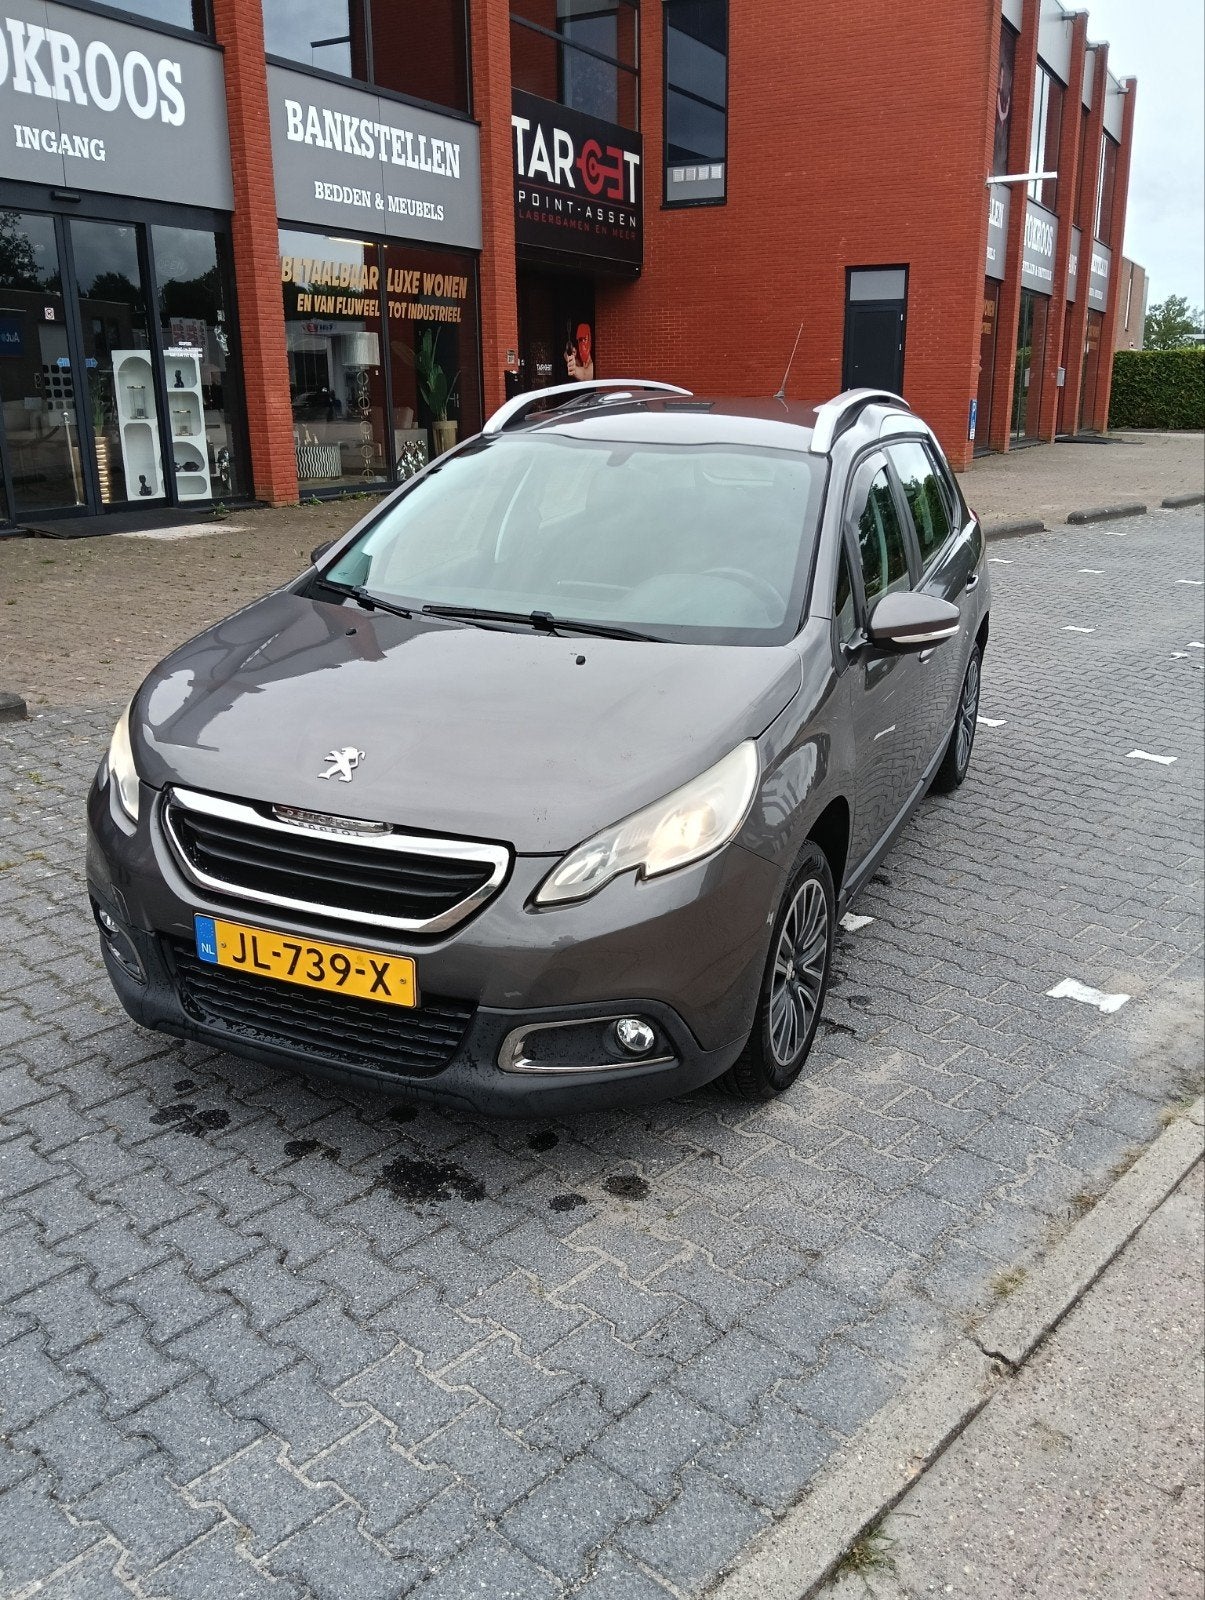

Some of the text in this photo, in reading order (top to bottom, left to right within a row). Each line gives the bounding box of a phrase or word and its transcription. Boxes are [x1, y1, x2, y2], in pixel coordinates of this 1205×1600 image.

[0, 17, 186, 127] KROOS
[14, 124, 106, 162] INGANG
[284, 99, 461, 179] BANKSTELLEN
[511, 115, 640, 204] TARGET
[314, 180, 444, 221] BEDDEN & MEUBELS
[518, 190, 636, 227] POINT-ASSEN
[518, 209, 636, 241] LASERGAMEN EN MEER
[281, 255, 467, 299] BETAALBAAR LUXE WONEN
[297, 294, 462, 323] EN VAN FLUWEEL TOT INDUSTRIEEL
[201, 942, 216, 955] NL
[232, 933, 392, 996] JL-739-X
